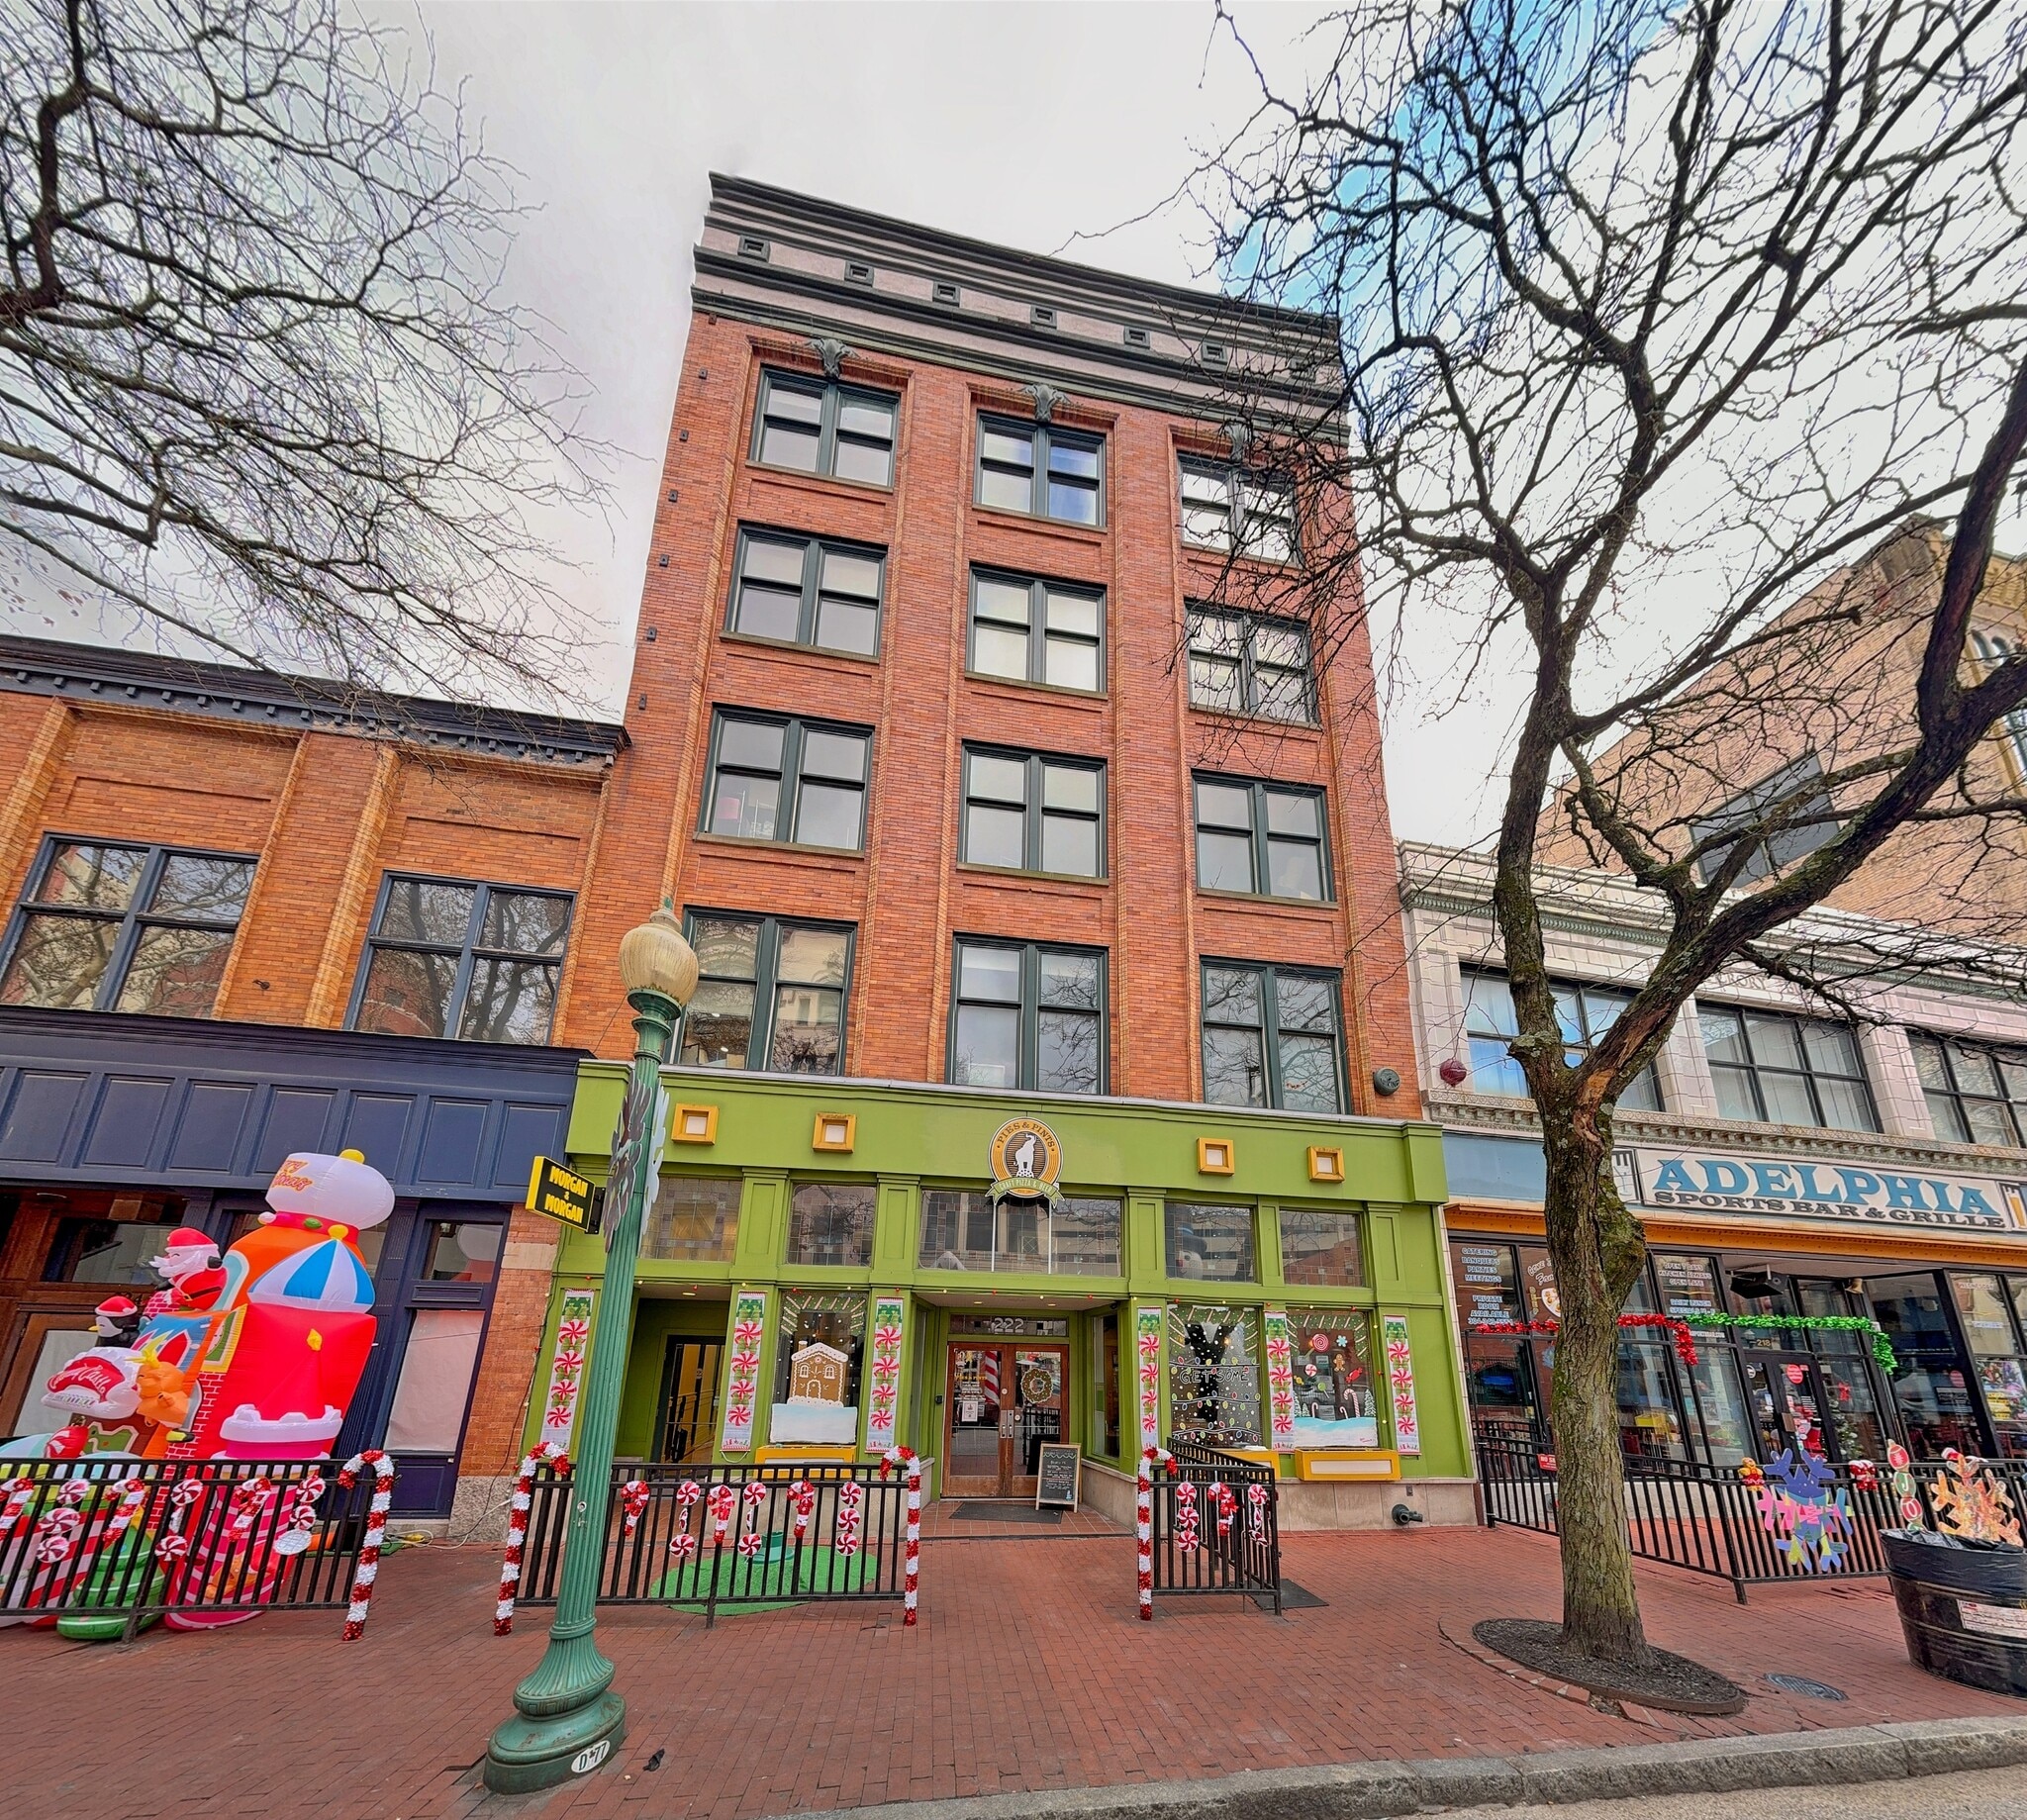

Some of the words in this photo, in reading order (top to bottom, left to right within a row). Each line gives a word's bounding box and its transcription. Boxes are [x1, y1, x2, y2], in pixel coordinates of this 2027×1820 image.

[998, 1122, 1020, 1144] PIES
[1031, 1122, 1056, 1148] PINTS
[548, 1165, 589, 1198] MORGAN
[999, 1179, 1015, 1192] CRAFT
[1015, 1178, 1031, 1188] PIZZA
[1039, 1181, 1053, 1193] BEER
[1652, 1159, 2001, 1217] ADELPHIA
[563, 1191, 570, 1201] &
[543, 1193, 584, 1224] MORGAN
[1654, 1191, 1786, 1212] SPORTS
[1789, 1199, 1861, 1217] BAR
[1864, 1206, 1886, 1219] &
[1888, 1208, 2007, 1229] GRILLE
[1461, 1247, 1497, 1256] CATERING
[1461, 1256, 1500, 1266] BANQUETS
[1467, 1265, 1497, 1274] PARTIES
[1464, 1274, 1502, 1283] MEETINGS
[1472, 1294, 1503, 1303] PRIVATE
[1470, 1309, 1510, 1319] AVAILABLE
[994, 1317, 1024, 1334] 222
[1756, 1338, 1772, 1347] 218
[1179, 1369, 1211, 1385] GET
[1215, 1369, 1250, 1384] SOME
